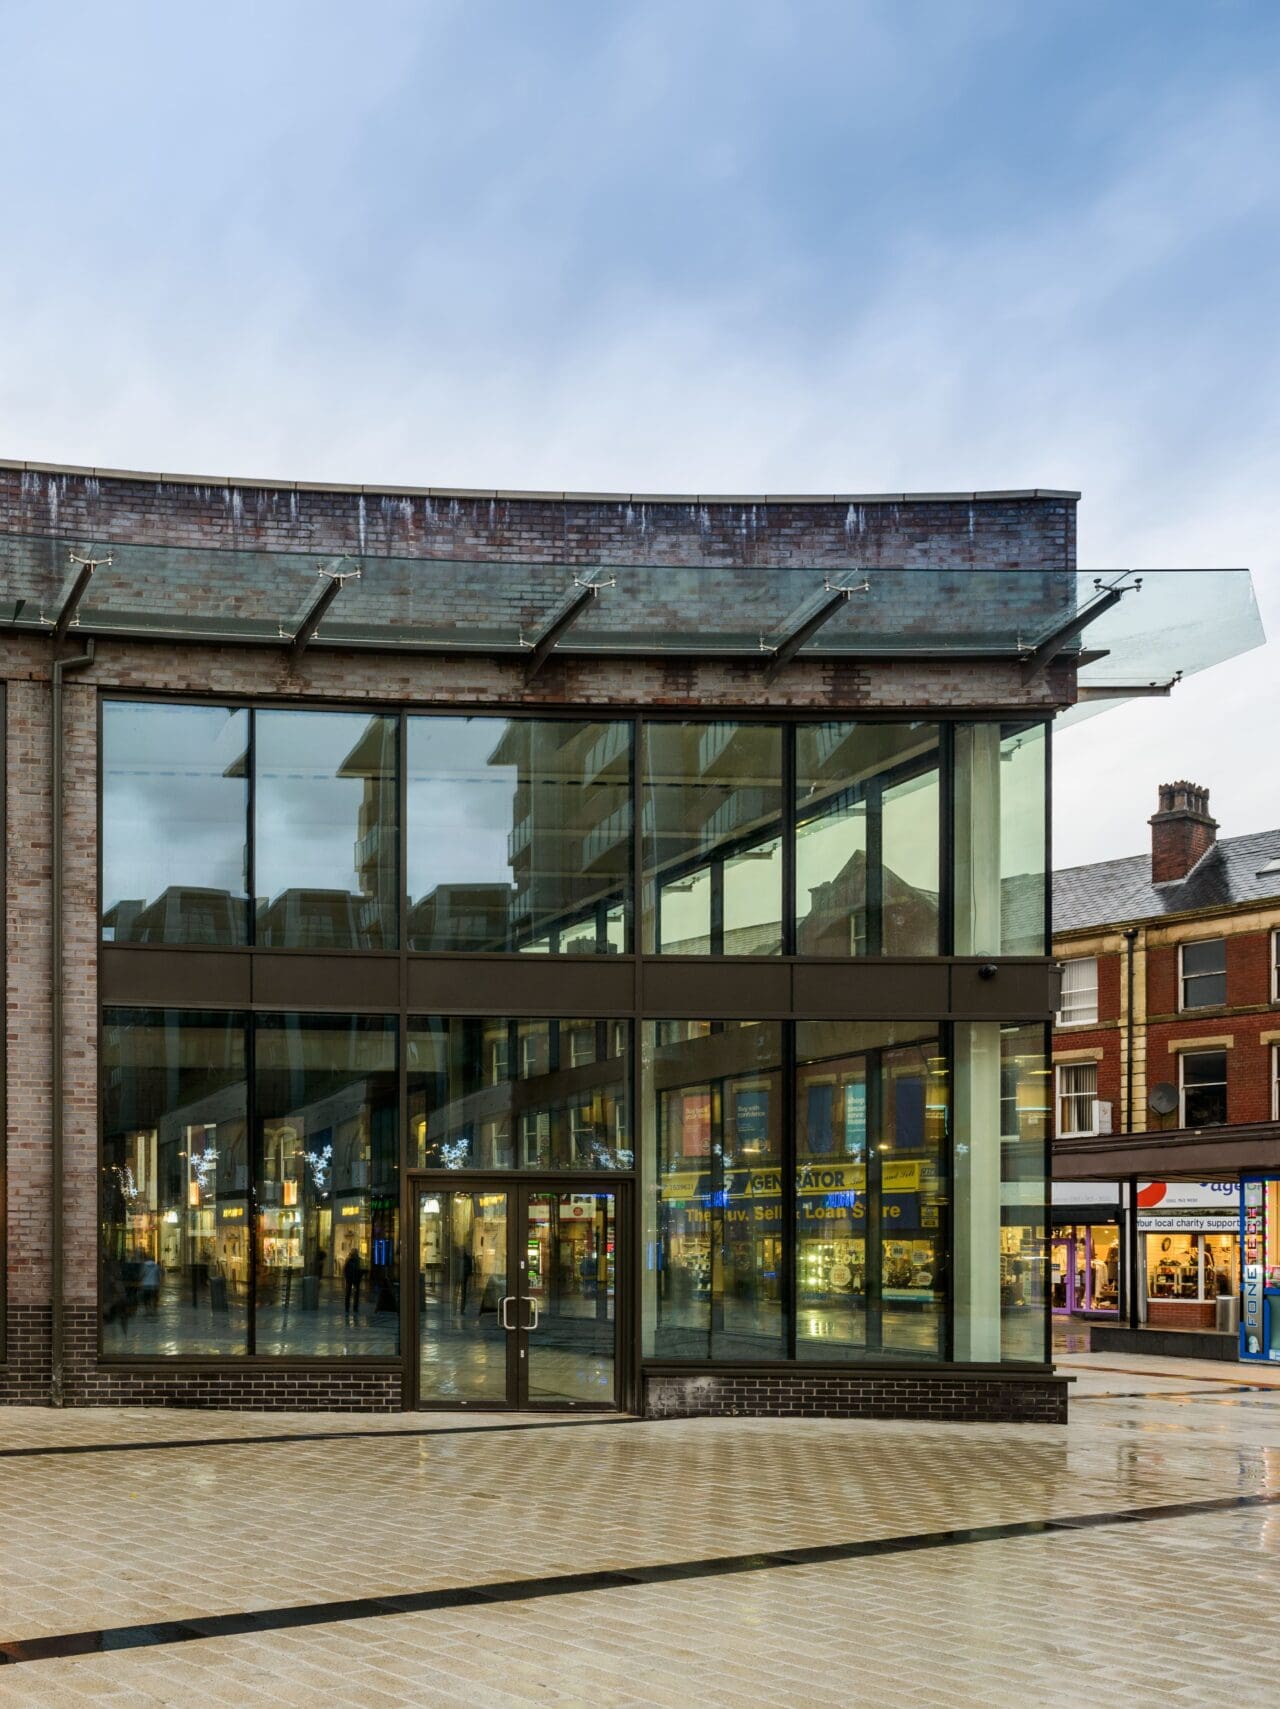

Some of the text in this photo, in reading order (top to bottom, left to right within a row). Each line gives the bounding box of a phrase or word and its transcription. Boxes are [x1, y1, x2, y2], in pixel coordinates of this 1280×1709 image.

[752, 1170, 845, 1191] GENRATOR
[686, 1208, 711, 1222] The
[805, 1205, 847, 1219] Loan
[852, 1202, 901, 1218] Sre
[1155, 1218, 1174, 1227] local
[1176, 1218, 1204, 1229] charity
